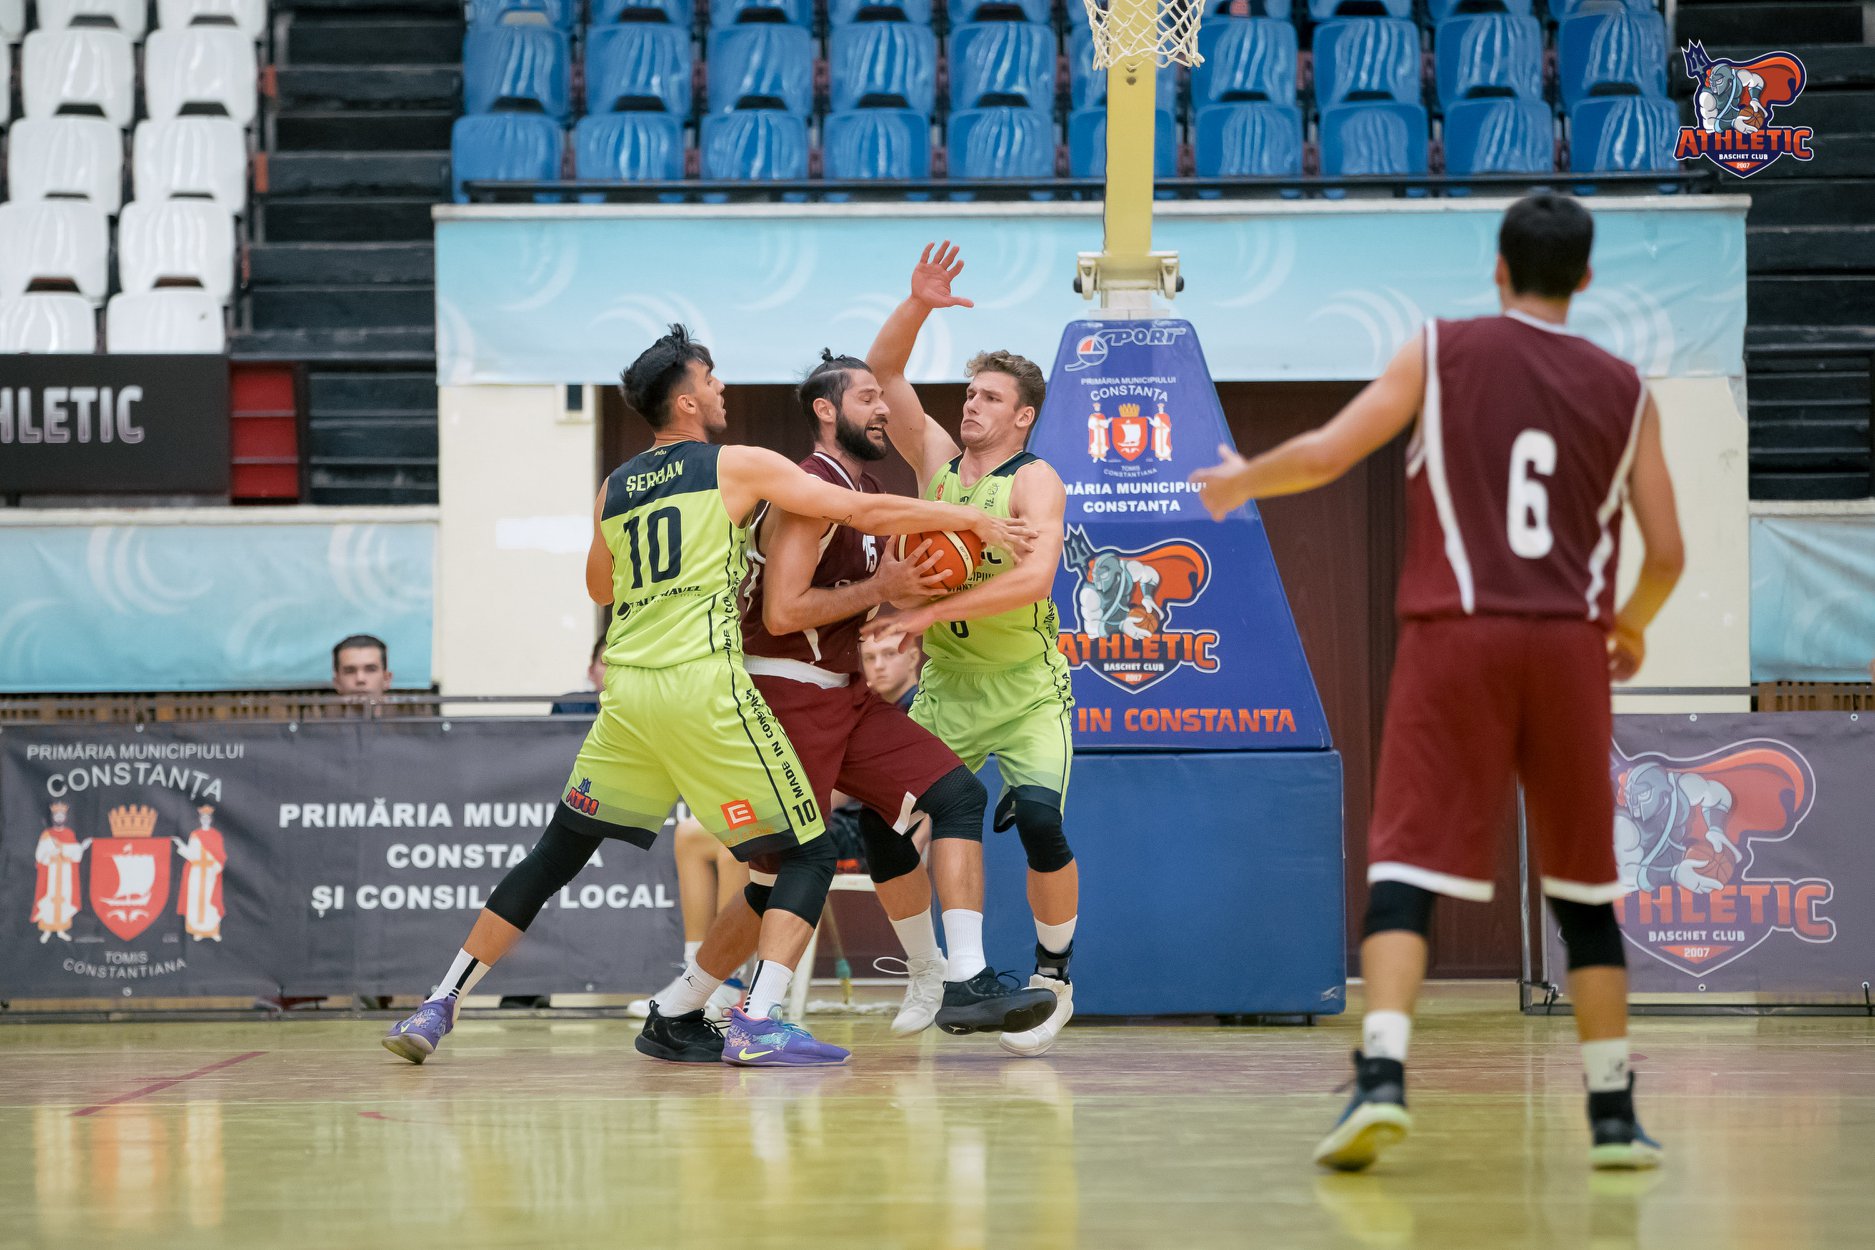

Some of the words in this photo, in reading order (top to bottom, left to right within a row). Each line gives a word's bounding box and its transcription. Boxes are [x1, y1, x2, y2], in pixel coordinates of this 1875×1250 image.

[1064, 481, 1112, 495] MĂRIA
[1116, 482, 1206, 494] MUNICIPIU
[1506, 427, 1557, 559] 6
[623, 506, 682, 589] 10
[1057, 633, 1216, 668] ATHLETIC
[1103, 662, 1141, 671] BASCHET
[1143, 662, 1164, 671] CLUB
[1078, 708, 1112, 732] IN
[1124, 708, 1297, 733] CONSTANTA
[119, 743, 245, 760] MUNICIPIULUI
[771, 741, 784, 757] IN
[781, 760, 804, 799] MADE
[278, 798, 453, 828] PRIMĂRIA
[792, 799, 817, 827] 10
[311, 885, 345, 918] ȘI
[559, 884, 675, 909] LOCAL
[1613, 884, 1831, 937] THLETIC
[1648, 931, 1707, 942] BASCHET
[1713, 930, 1745, 941] CLUB
[105, 952, 148, 965] TOMIS
[1684, 947, 1710, 958] 2007
[63, 957, 187, 979] CONSTANTIANA
